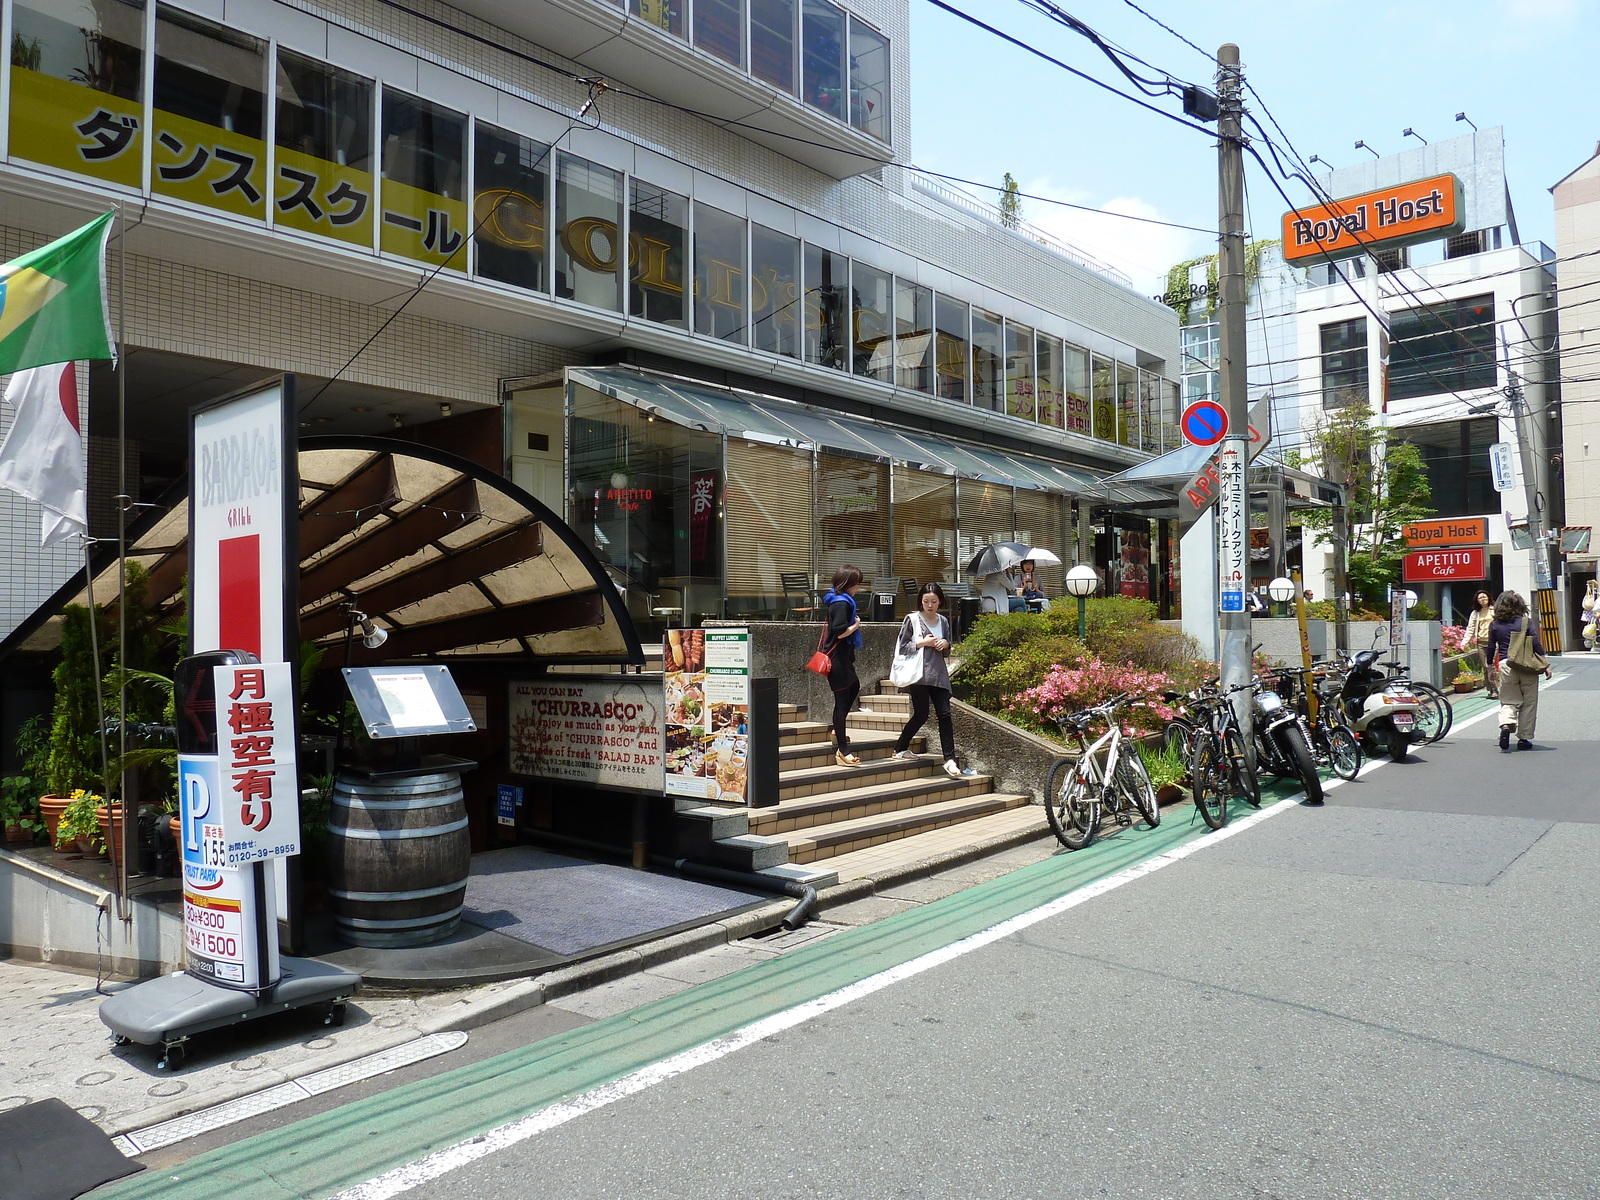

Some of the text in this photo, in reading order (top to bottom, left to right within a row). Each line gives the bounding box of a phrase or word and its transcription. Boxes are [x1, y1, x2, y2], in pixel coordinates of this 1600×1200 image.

[76, 108, 463, 256] ダンススクール
[1292, 189, 1444, 246] Royal Host
[202, 422, 278, 507] BARBACOA
[607, 489, 653, 501] APETITO
[619, 502, 639, 511] Cafe
[226, 506, 252, 528] GRILL
[1409, 525, 1477, 541] Royal Host
[1417, 552, 1471, 567] APETITO
[1432, 566, 1455, 576] Cafe
[516, 686, 584, 698] ALL YOU CAN EAT
[531, 698, 644, 720] "CHURRASCO"
[537, 717, 562, 730] enjoy
[564, 720, 574, 729] as
[576, 719, 602, 731] much
[605, 724, 615, 732] as
[618, 724, 636, 735] you
[554, 732, 563, 742] of
[565, 733, 635, 748] "CHURRASCO"
[637, 739, 658, 750] and
[227, 668, 276, 833] 月極空有り
[555, 746, 565, 757] of
[566, 748, 591, 760] fresh
[184, 771, 211, 854] P
[229, 843, 296, 863] 0120-39-8959
[185, 864, 218, 883] TRUST PARK
